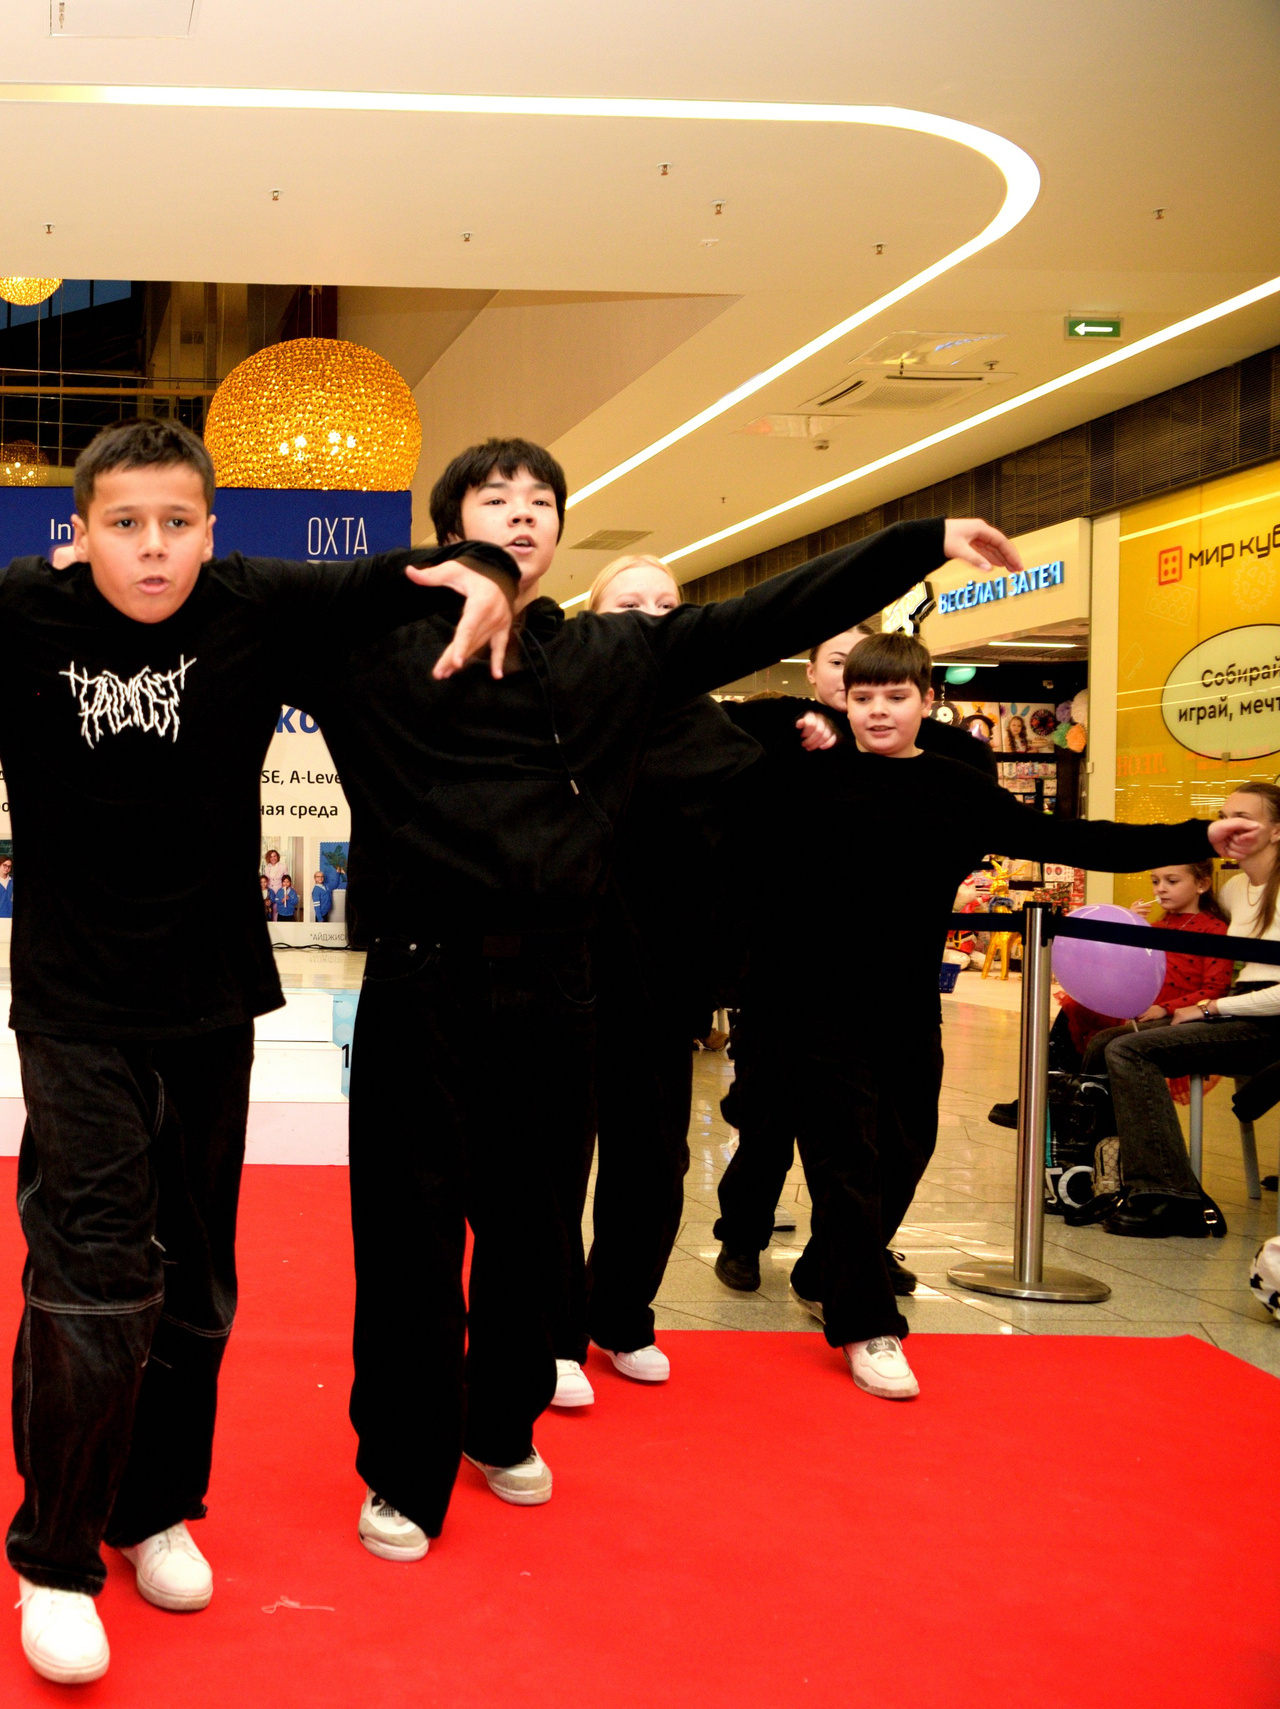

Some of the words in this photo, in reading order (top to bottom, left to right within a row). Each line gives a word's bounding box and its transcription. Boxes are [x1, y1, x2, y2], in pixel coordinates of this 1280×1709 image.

[50, 518, 75, 540] In
[938, 580, 1008, 615] ВЕСЁЛАЯ
[1008, 561, 1064, 597] ЗАТЕЯ
[1178, 695, 1233, 725] играй,
[290, 804, 338, 819] среда
